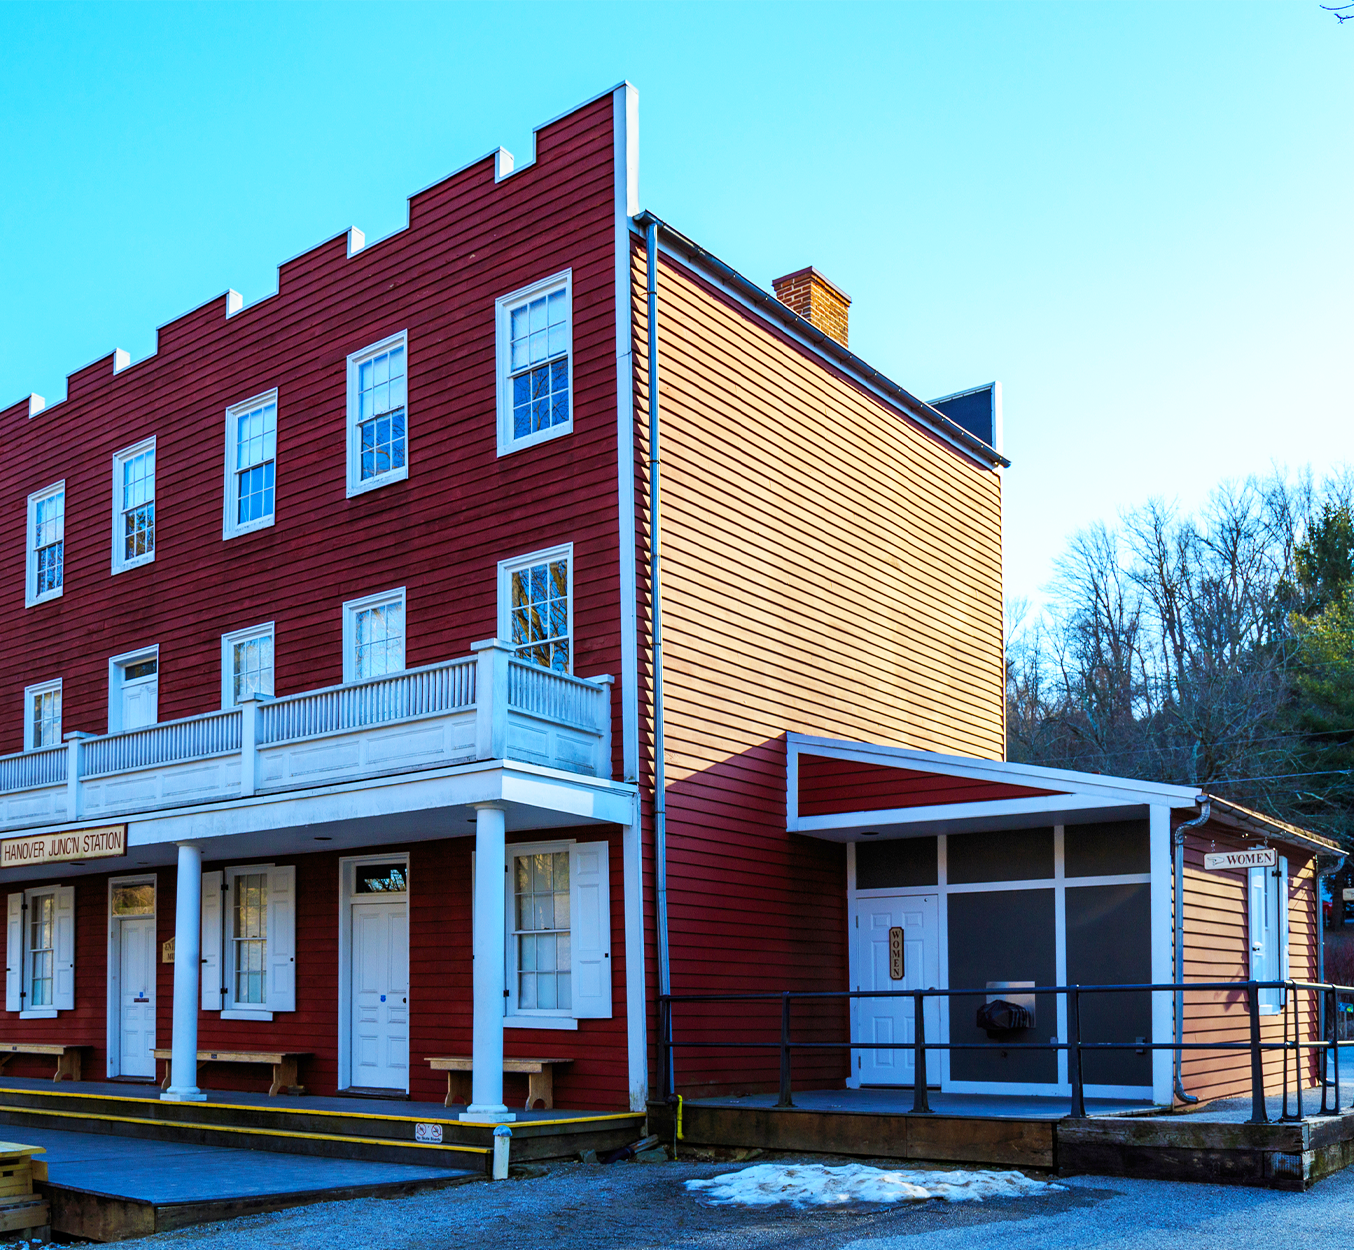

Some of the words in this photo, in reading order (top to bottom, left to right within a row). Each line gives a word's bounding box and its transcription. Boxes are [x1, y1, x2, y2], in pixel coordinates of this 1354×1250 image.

[4, 841, 45, 861] HANOVER
[48, 836, 80, 857] JUNC'N
[82, 831, 122, 853] STATION
[1226, 852, 1272, 865] WOMEN
[891, 930, 901, 977] WOMEN
